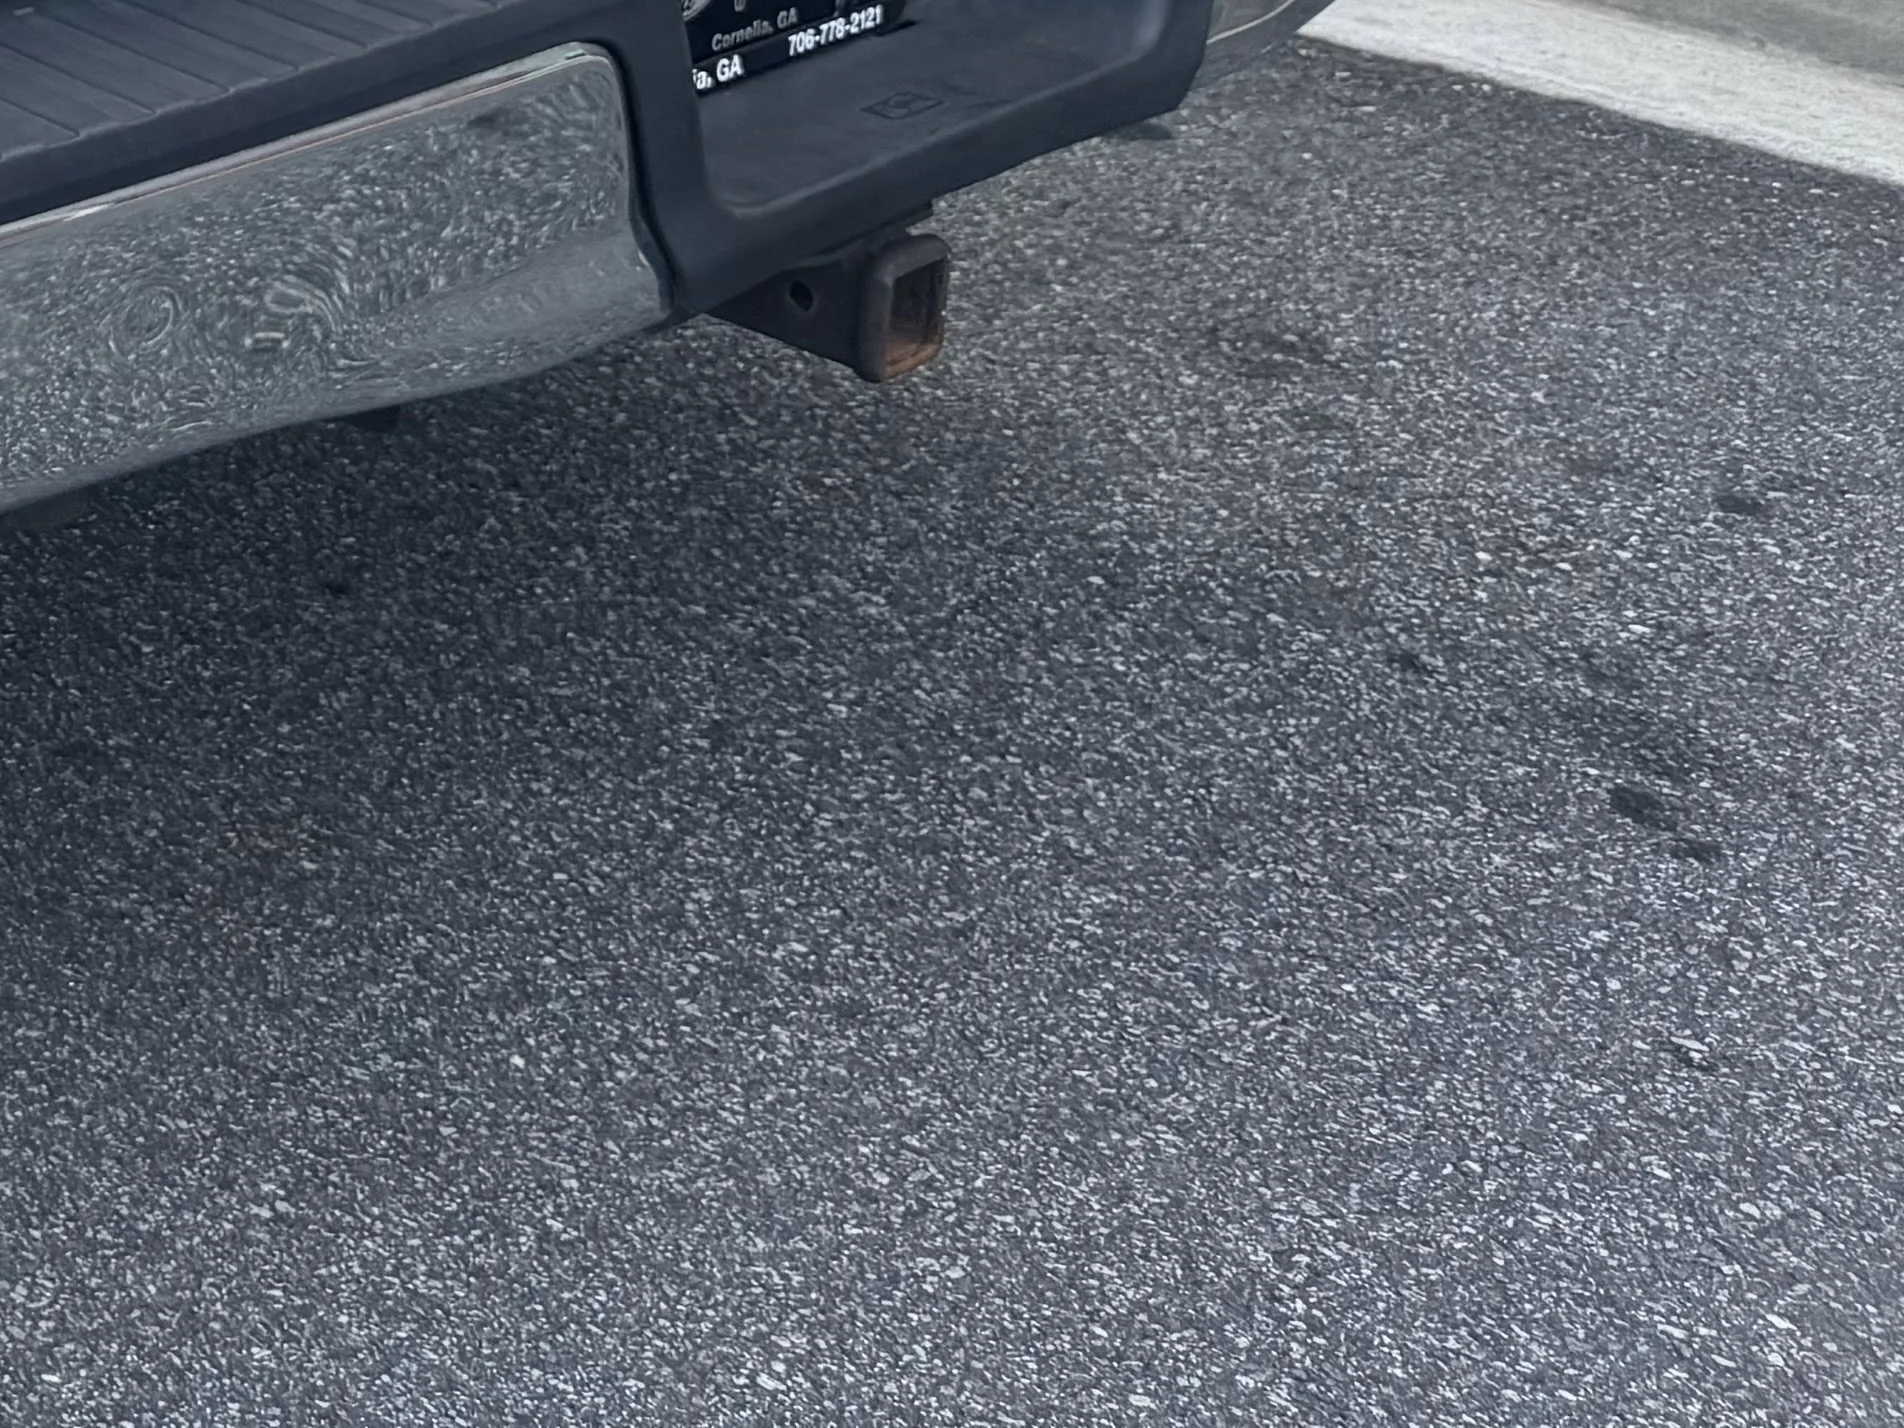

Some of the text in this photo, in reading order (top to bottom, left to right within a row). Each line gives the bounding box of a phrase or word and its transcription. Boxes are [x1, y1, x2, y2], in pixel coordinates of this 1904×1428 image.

[776, 7, 799, 31] GA
[788, 3, 885, 57] 706-778-2121
[716, 54, 744, 83] GA
